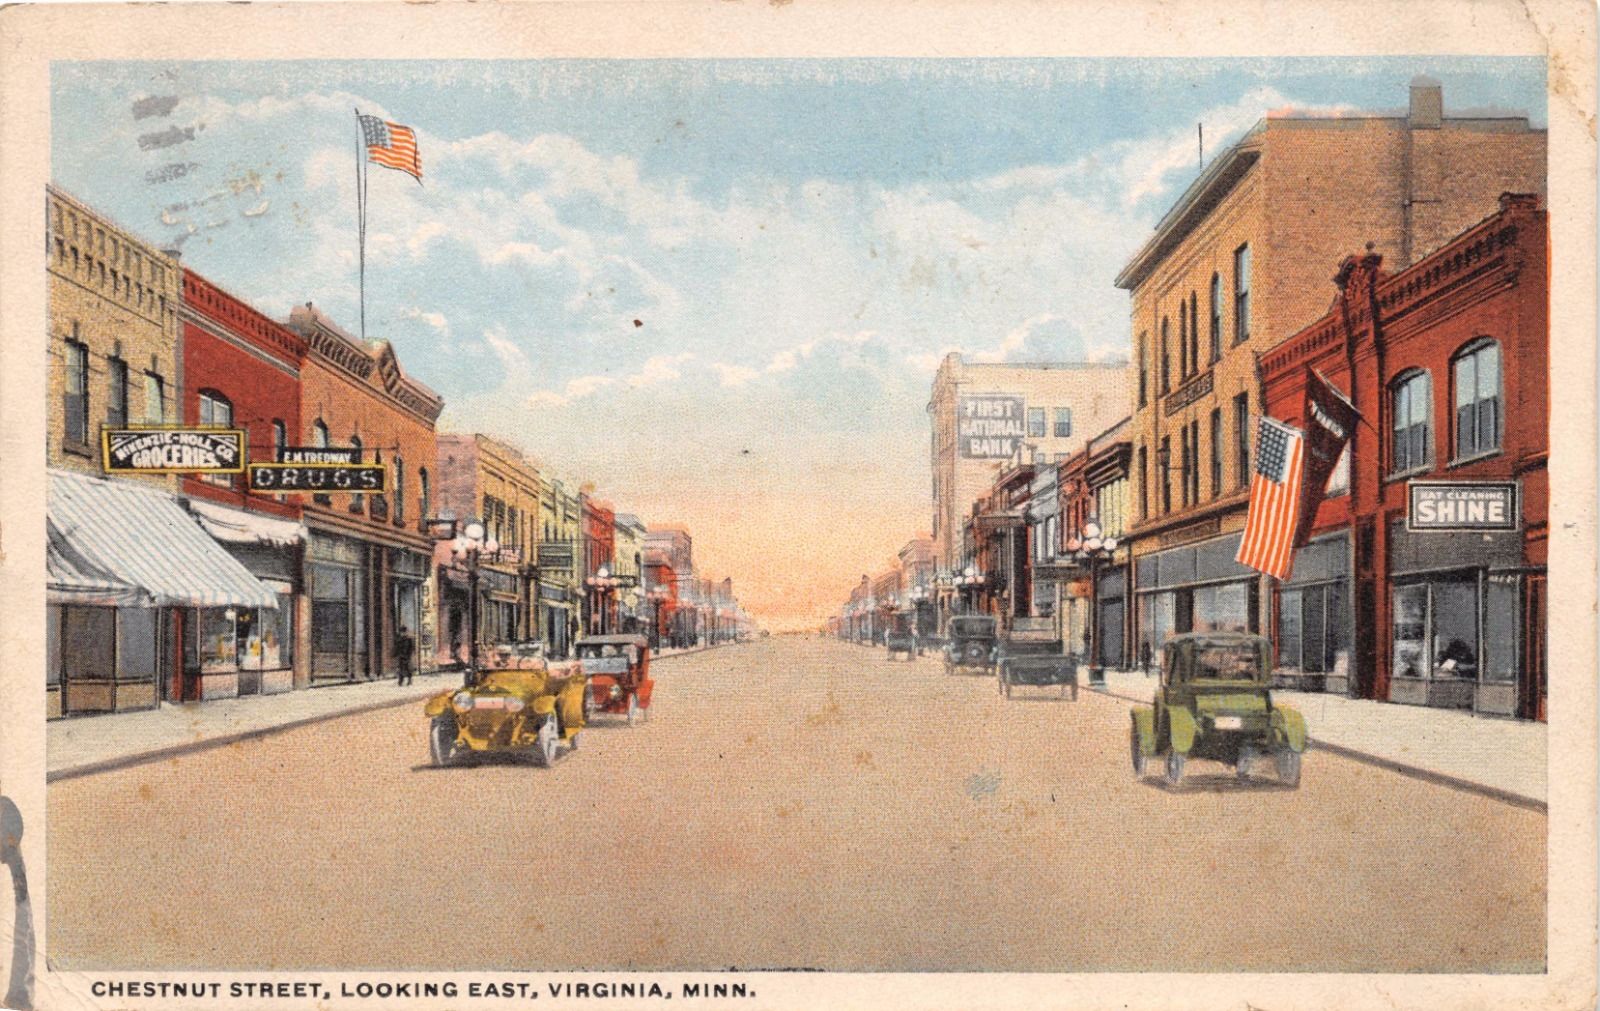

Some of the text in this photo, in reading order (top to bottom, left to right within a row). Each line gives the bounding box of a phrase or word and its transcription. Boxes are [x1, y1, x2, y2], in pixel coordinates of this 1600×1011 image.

[966, 401, 1014, 416] FIRST
[961, 420, 1024, 435] NATIONAL
[971, 439, 1013, 455] BANK
[256, 468, 376, 488] DRUGS
[1446, 491, 1505, 500] CLEANING
[1418, 500, 1505, 522] SHINE
